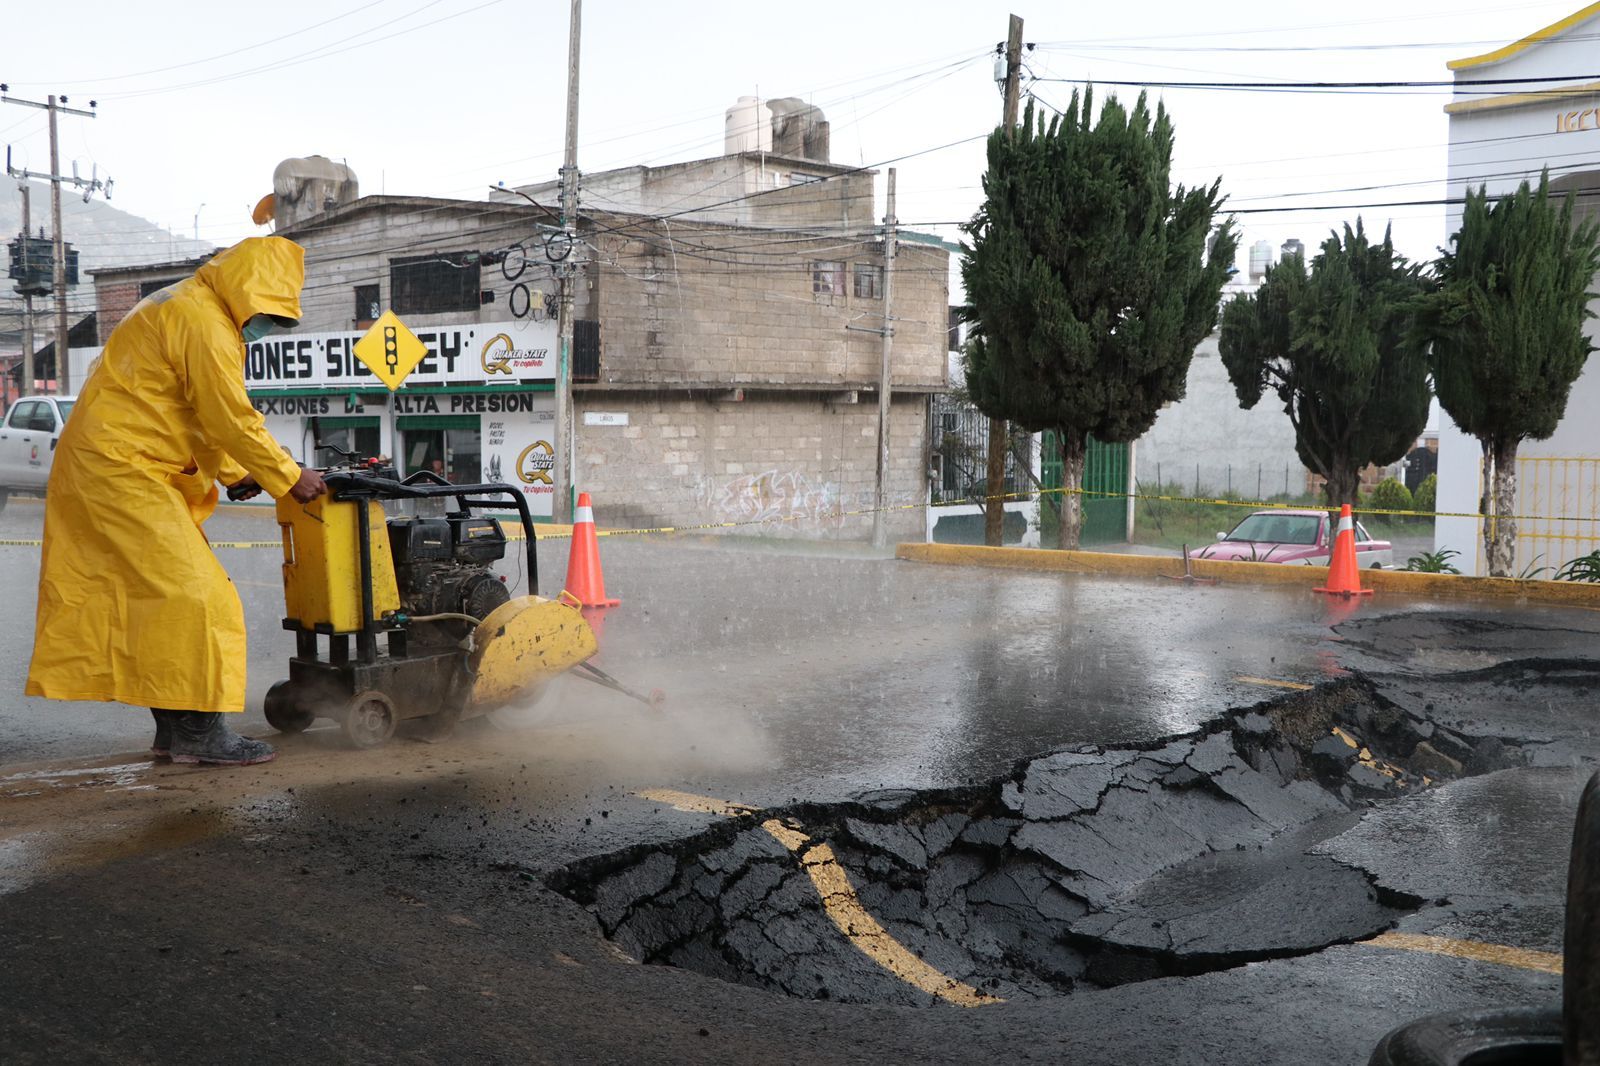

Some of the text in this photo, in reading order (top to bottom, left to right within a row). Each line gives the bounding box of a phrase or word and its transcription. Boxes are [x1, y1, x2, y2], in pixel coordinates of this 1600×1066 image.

[492, 348, 548, 360] QUAKER STATE
[253, 397, 329, 415] EXIONES
[394, 395, 439, 414] ALTA
[451, 393, 533, 413] PRESION
[530, 452, 554, 463] QUAKE
[532, 461, 554, 470] STATE
